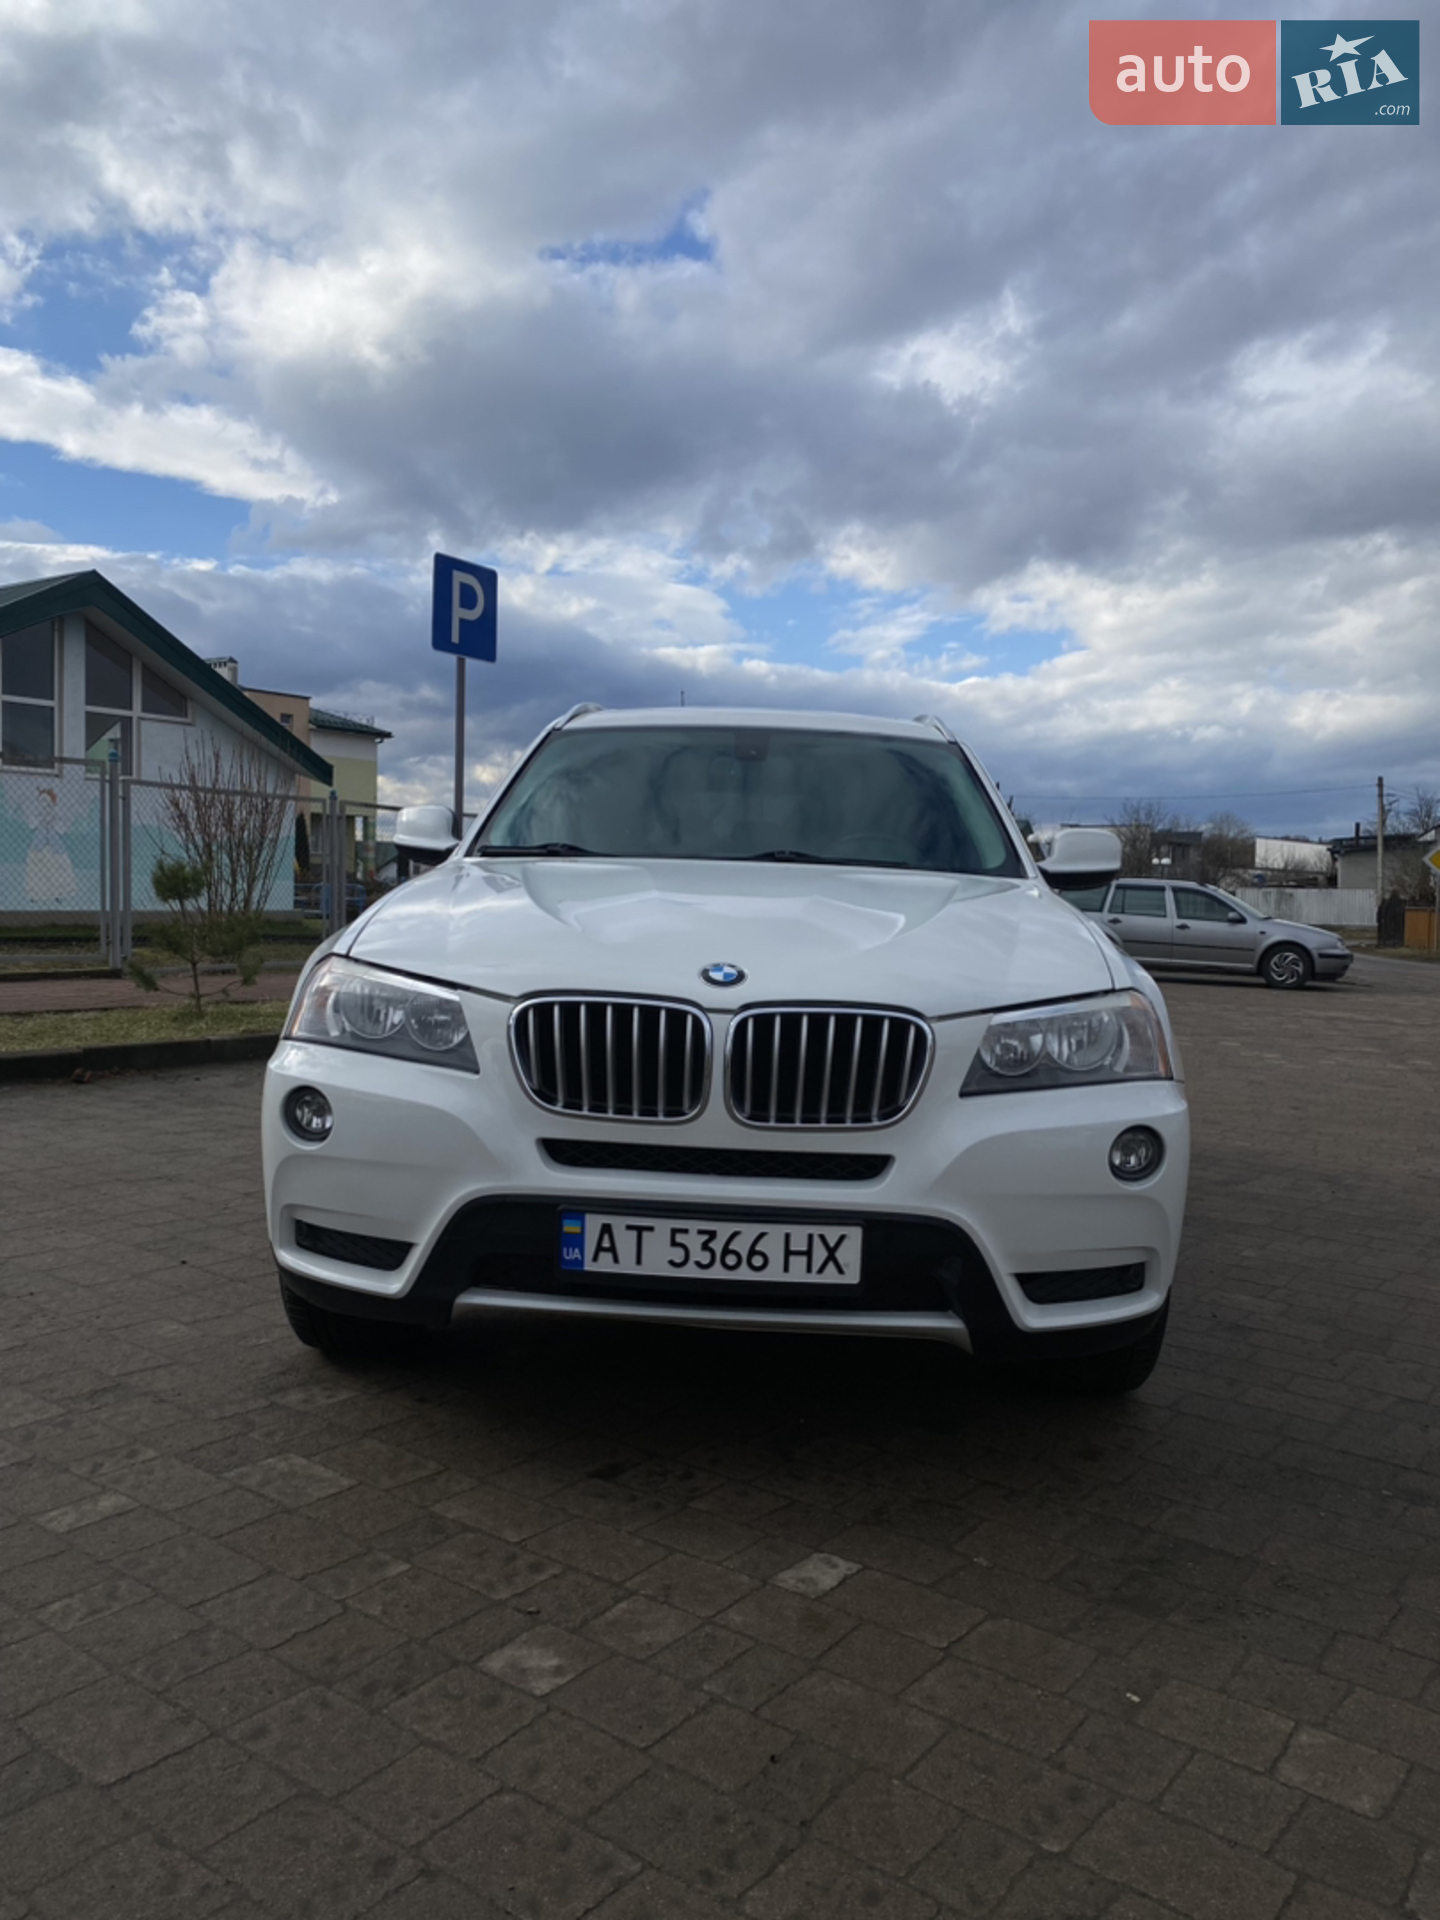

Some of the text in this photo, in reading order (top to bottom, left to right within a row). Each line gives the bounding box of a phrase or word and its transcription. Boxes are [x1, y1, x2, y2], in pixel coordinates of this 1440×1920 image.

[451, 569, 485, 644] P
[563, 1247, 582, 1261] UA
[591, 1222, 848, 1275] AT 5366 HX
